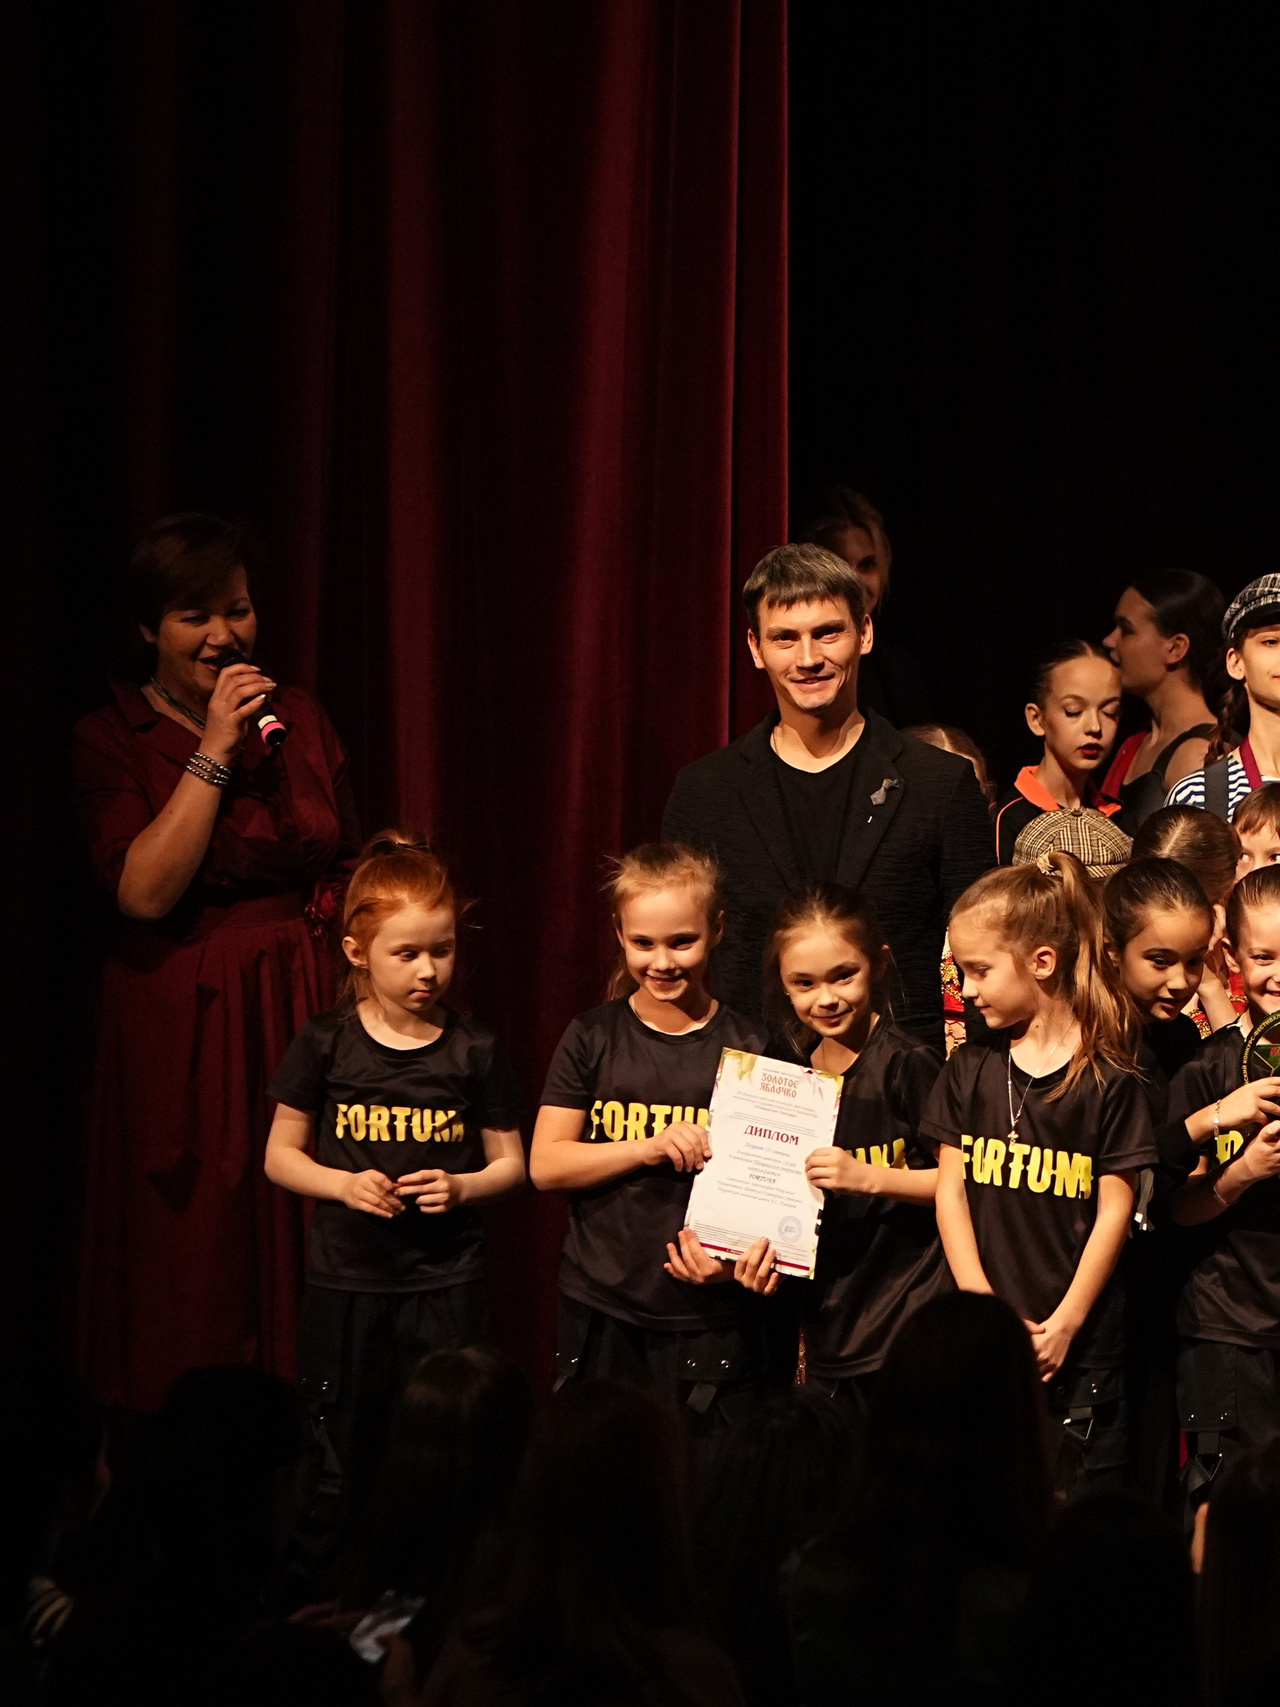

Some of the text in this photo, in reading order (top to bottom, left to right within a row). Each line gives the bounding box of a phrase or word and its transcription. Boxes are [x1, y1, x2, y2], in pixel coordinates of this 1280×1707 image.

[336, 1103, 464, 1143] FORTUNA
[590, 1100, 712, 1144] FORTU
[743, 1125, 799, 1145] ДИПЛОМ
